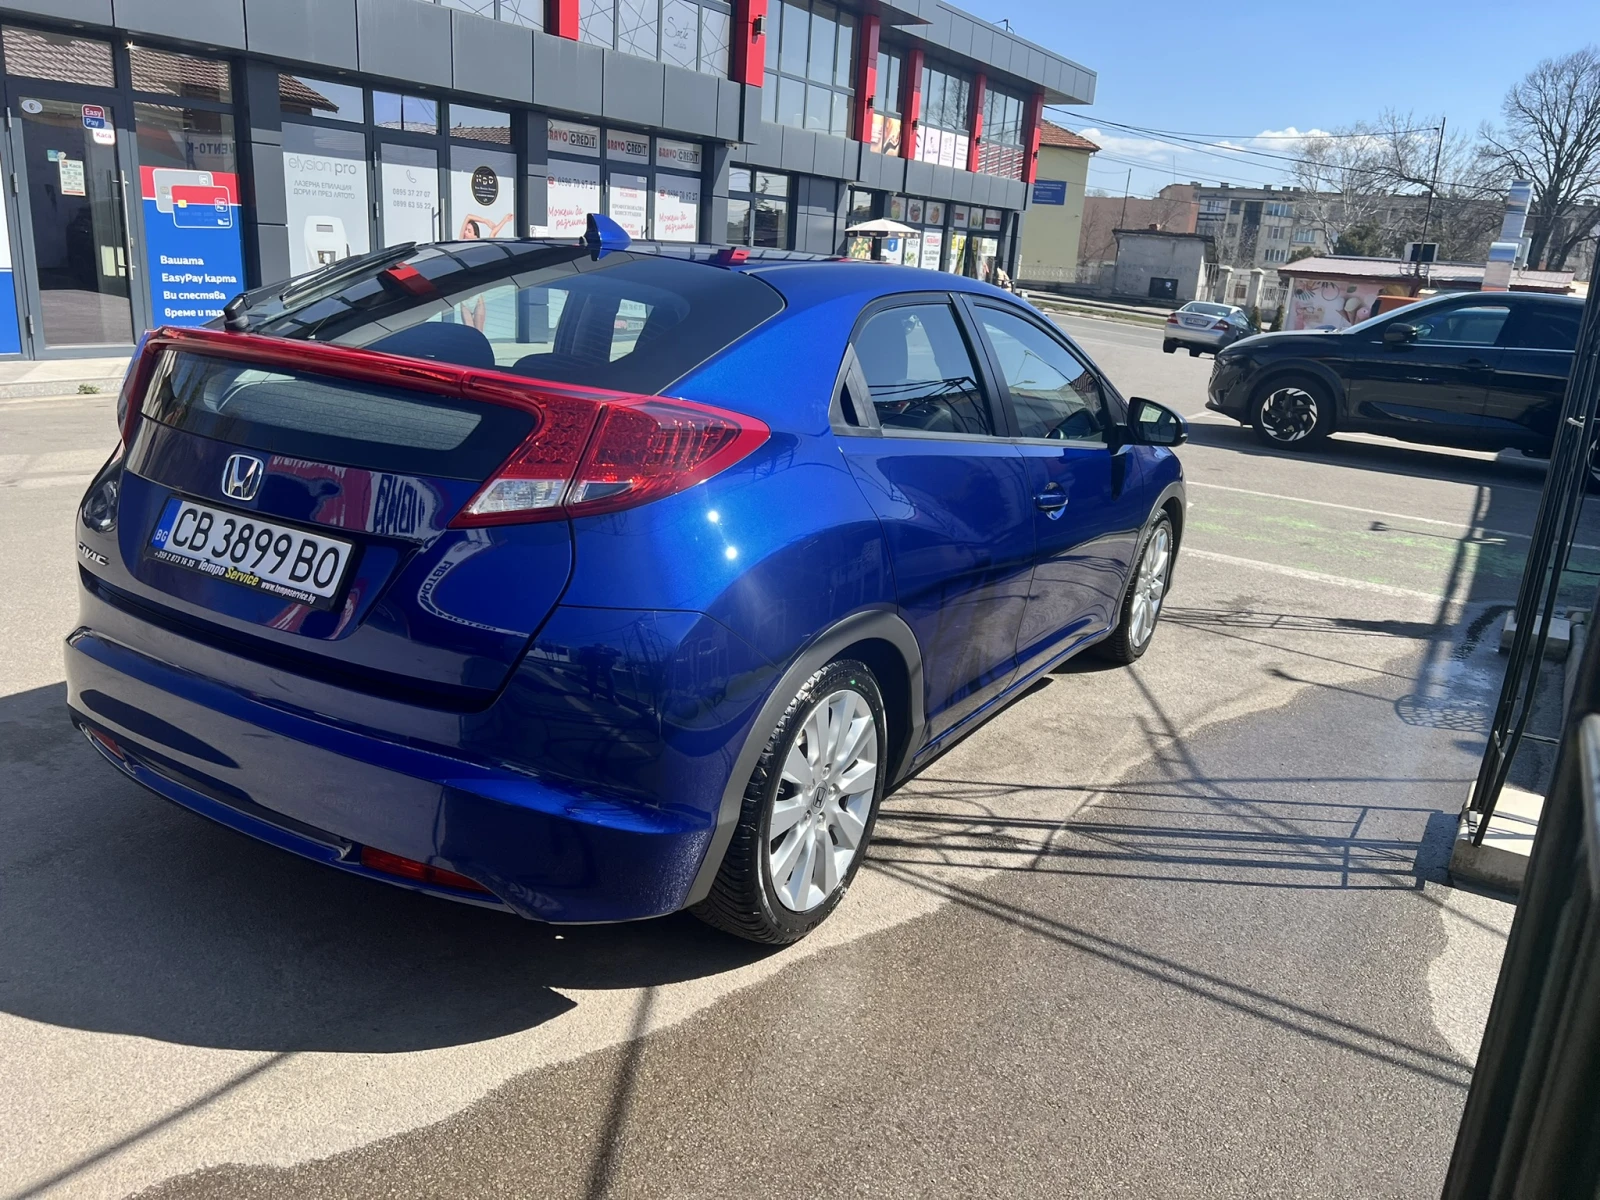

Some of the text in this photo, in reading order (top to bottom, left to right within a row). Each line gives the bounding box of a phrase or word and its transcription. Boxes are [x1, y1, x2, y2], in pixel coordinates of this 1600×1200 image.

[84, 107, 102, 116] Easy
[86, 118, 98, 127] Pay
[548, 130, 596, 148] RAVO CREDIT
[608, 140, 647, 156] BRAVO CREDIT
[658, 148, 698, 164] BRAVO CREDIT
[288, 156, 356, 176] elysion pro
[294, 180, 352, 191] ЛАЗЕРНА ЕПИЛАЦИЯ
[294, 188, 311, 196] ДОРИ
[318, 190, 332, 198] ПРЕЗ
[393, 188, 406, 196] 0895
[393, 200, 406, 208] 0899
[160, 255, 204, 265] Вашата
[162, 273, 237, 284] EasyPay карта
[163, 291, 226, 299] Ви спестява
[165, 308, 196, 318] време
[155, 528, 168, 542] BG
[78, 541, 109, 566] CIVIC
[172, 508, 340, 589] CB 3899 BO
[198, 558, 226, 576] Tempo
[225, 566, 259, 586] Service
[261, 582, 316, 604] www.temposervice.bg
